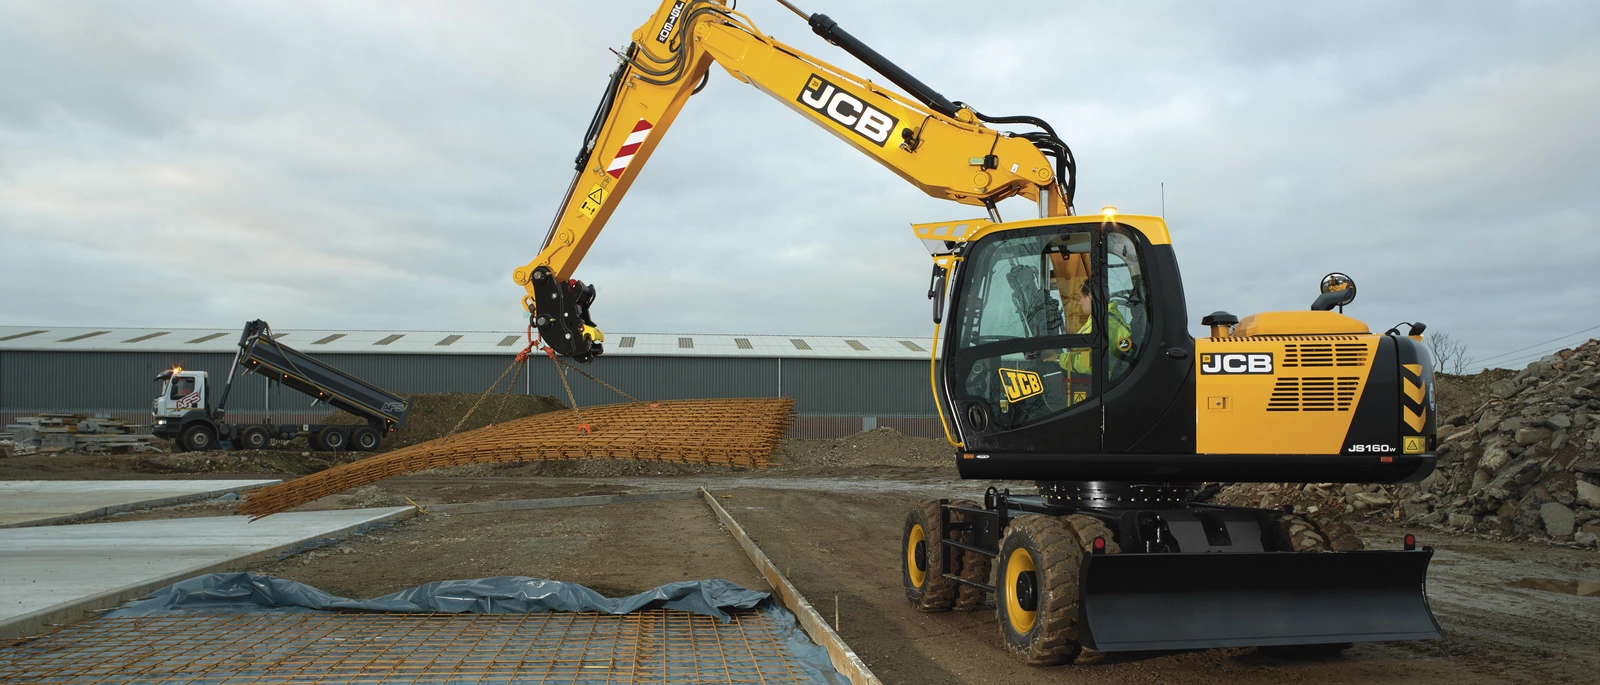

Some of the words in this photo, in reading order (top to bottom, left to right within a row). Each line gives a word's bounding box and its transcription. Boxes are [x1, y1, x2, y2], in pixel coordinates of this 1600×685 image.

[802, 84, 893, 143] JCB
[1202, 354, 1272, 373] JCB
[1006, 371, 1041, 399] JCB
[176, 391, 201, 412] AFS
[381, 402, 405, 412] AFS
